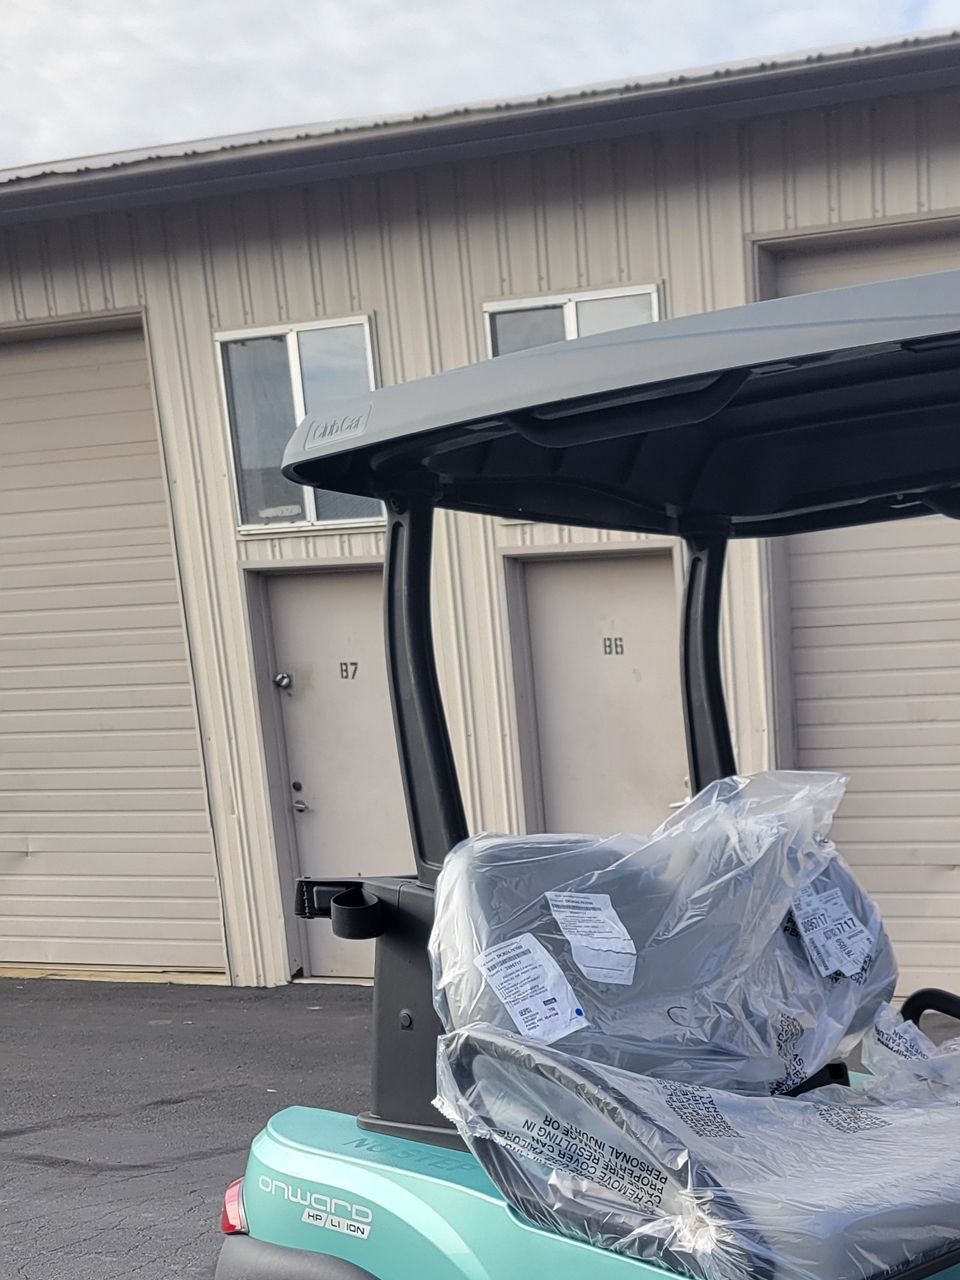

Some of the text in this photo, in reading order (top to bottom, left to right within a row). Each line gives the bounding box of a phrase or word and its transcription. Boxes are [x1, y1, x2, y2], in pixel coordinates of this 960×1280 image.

[522, 1118, 537, 1130] IN
[542, 1114, 561, 1131] OR
[531, 1136, 555, 1153] CAN
[538, 1127, 600, 1164] RESULTING
[557, 1149, 598, 1175] COVER
[601, 1164, 626, 1182] FIRE
[608, 1144, 668, 1184] PERSONAL
[598, 1173, 644, 1205] REMOVE
[307, 1212, 323, 1222] HP
[346, 1222, 366, 1236] ION
